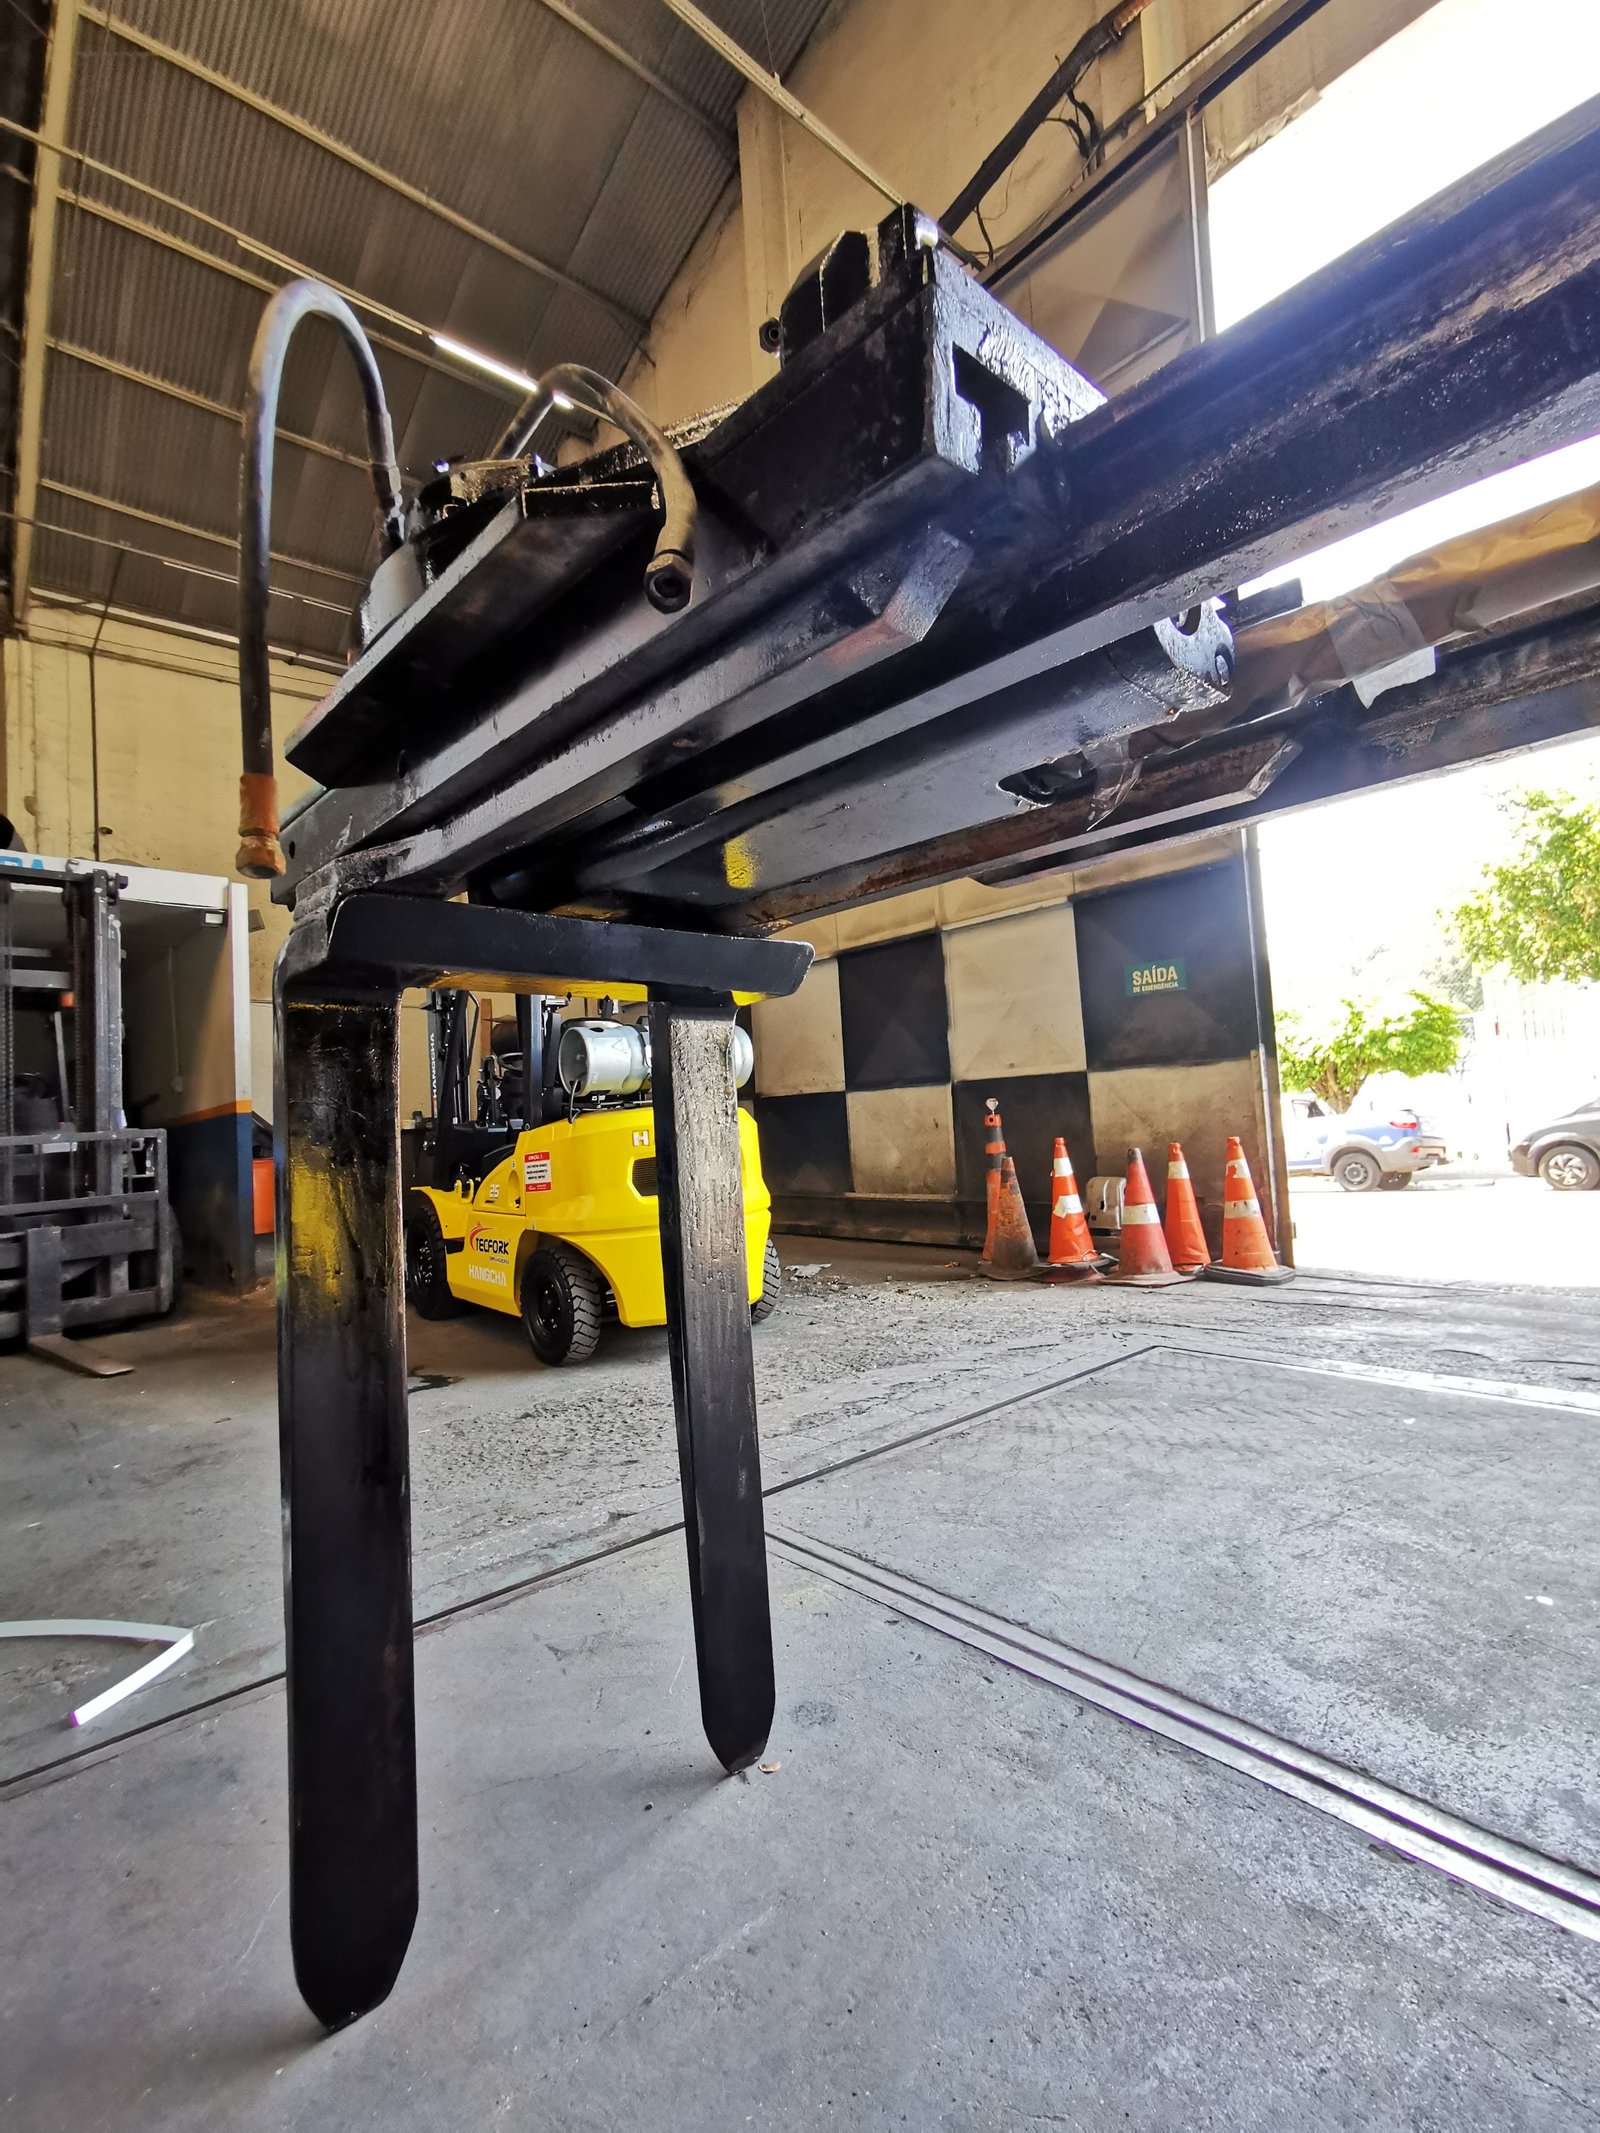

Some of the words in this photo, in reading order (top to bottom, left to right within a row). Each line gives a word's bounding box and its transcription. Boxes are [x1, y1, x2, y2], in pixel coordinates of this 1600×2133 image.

[1132, 965, 1178, 985] SAÍDA
[475, 1238, 509, 1255] TECFORK
[468, 1264, 507, 1286] HANGCHA
